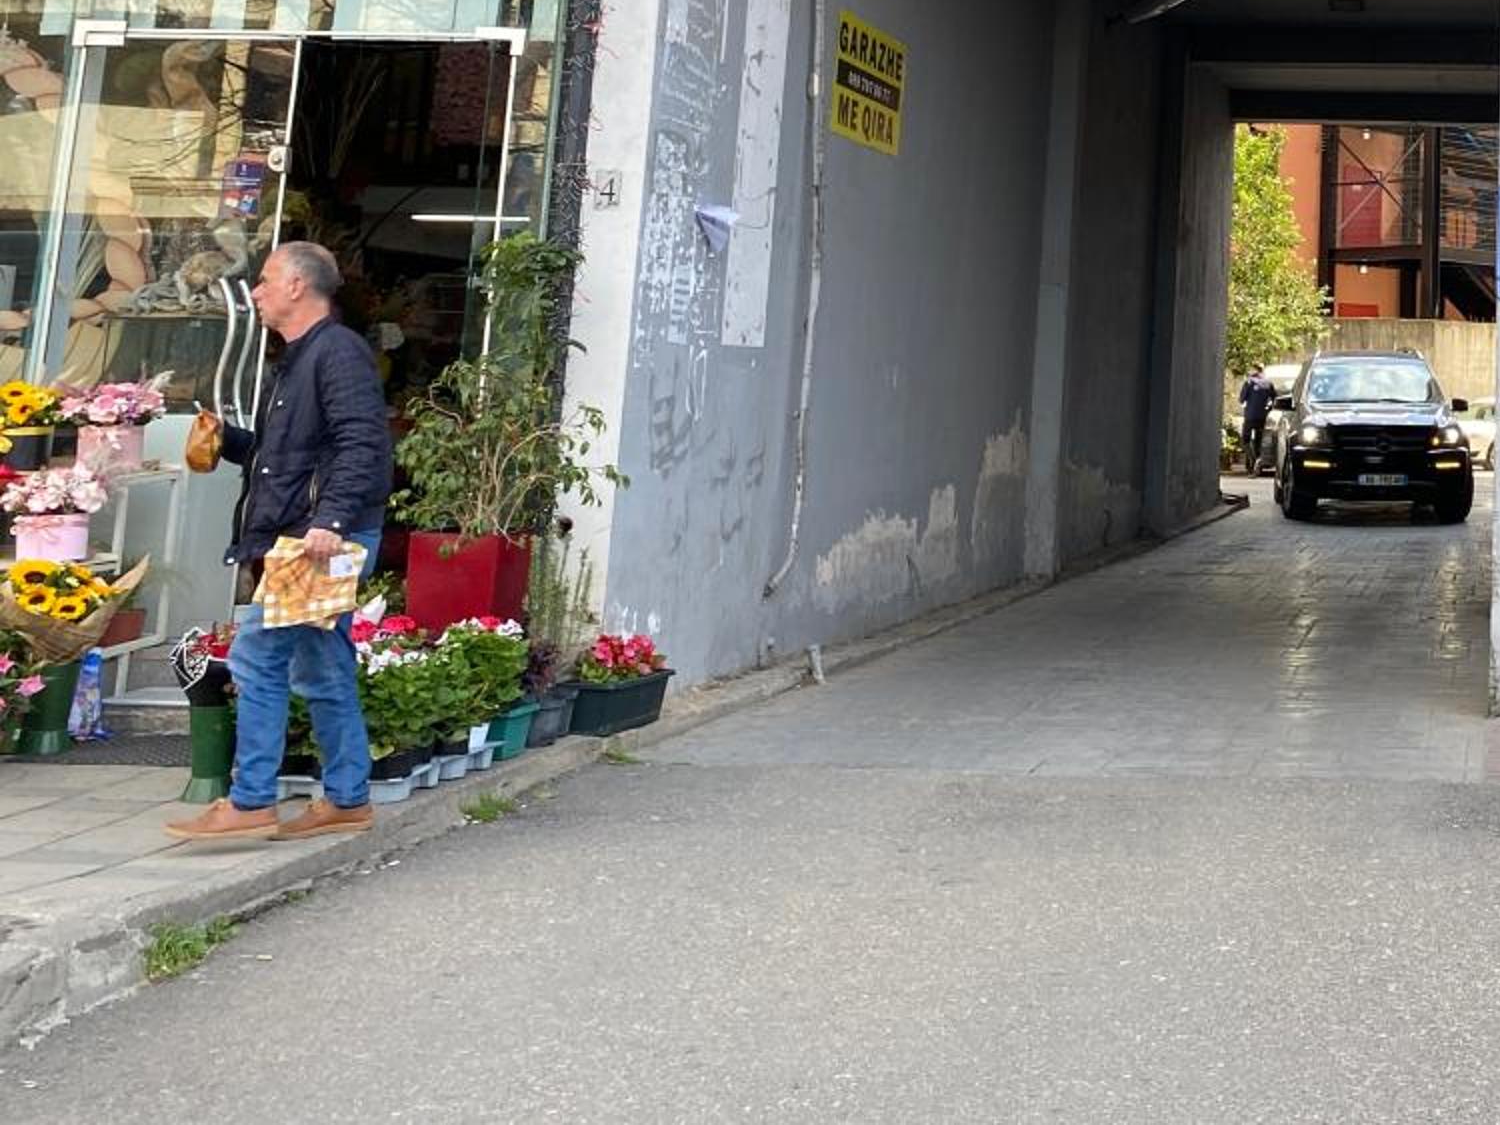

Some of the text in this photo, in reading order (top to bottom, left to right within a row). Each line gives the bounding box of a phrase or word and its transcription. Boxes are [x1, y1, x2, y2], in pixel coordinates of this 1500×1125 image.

[839, 21, 904, 82] GARAZHE
[838, 94, 893, 145] ME QIRA
